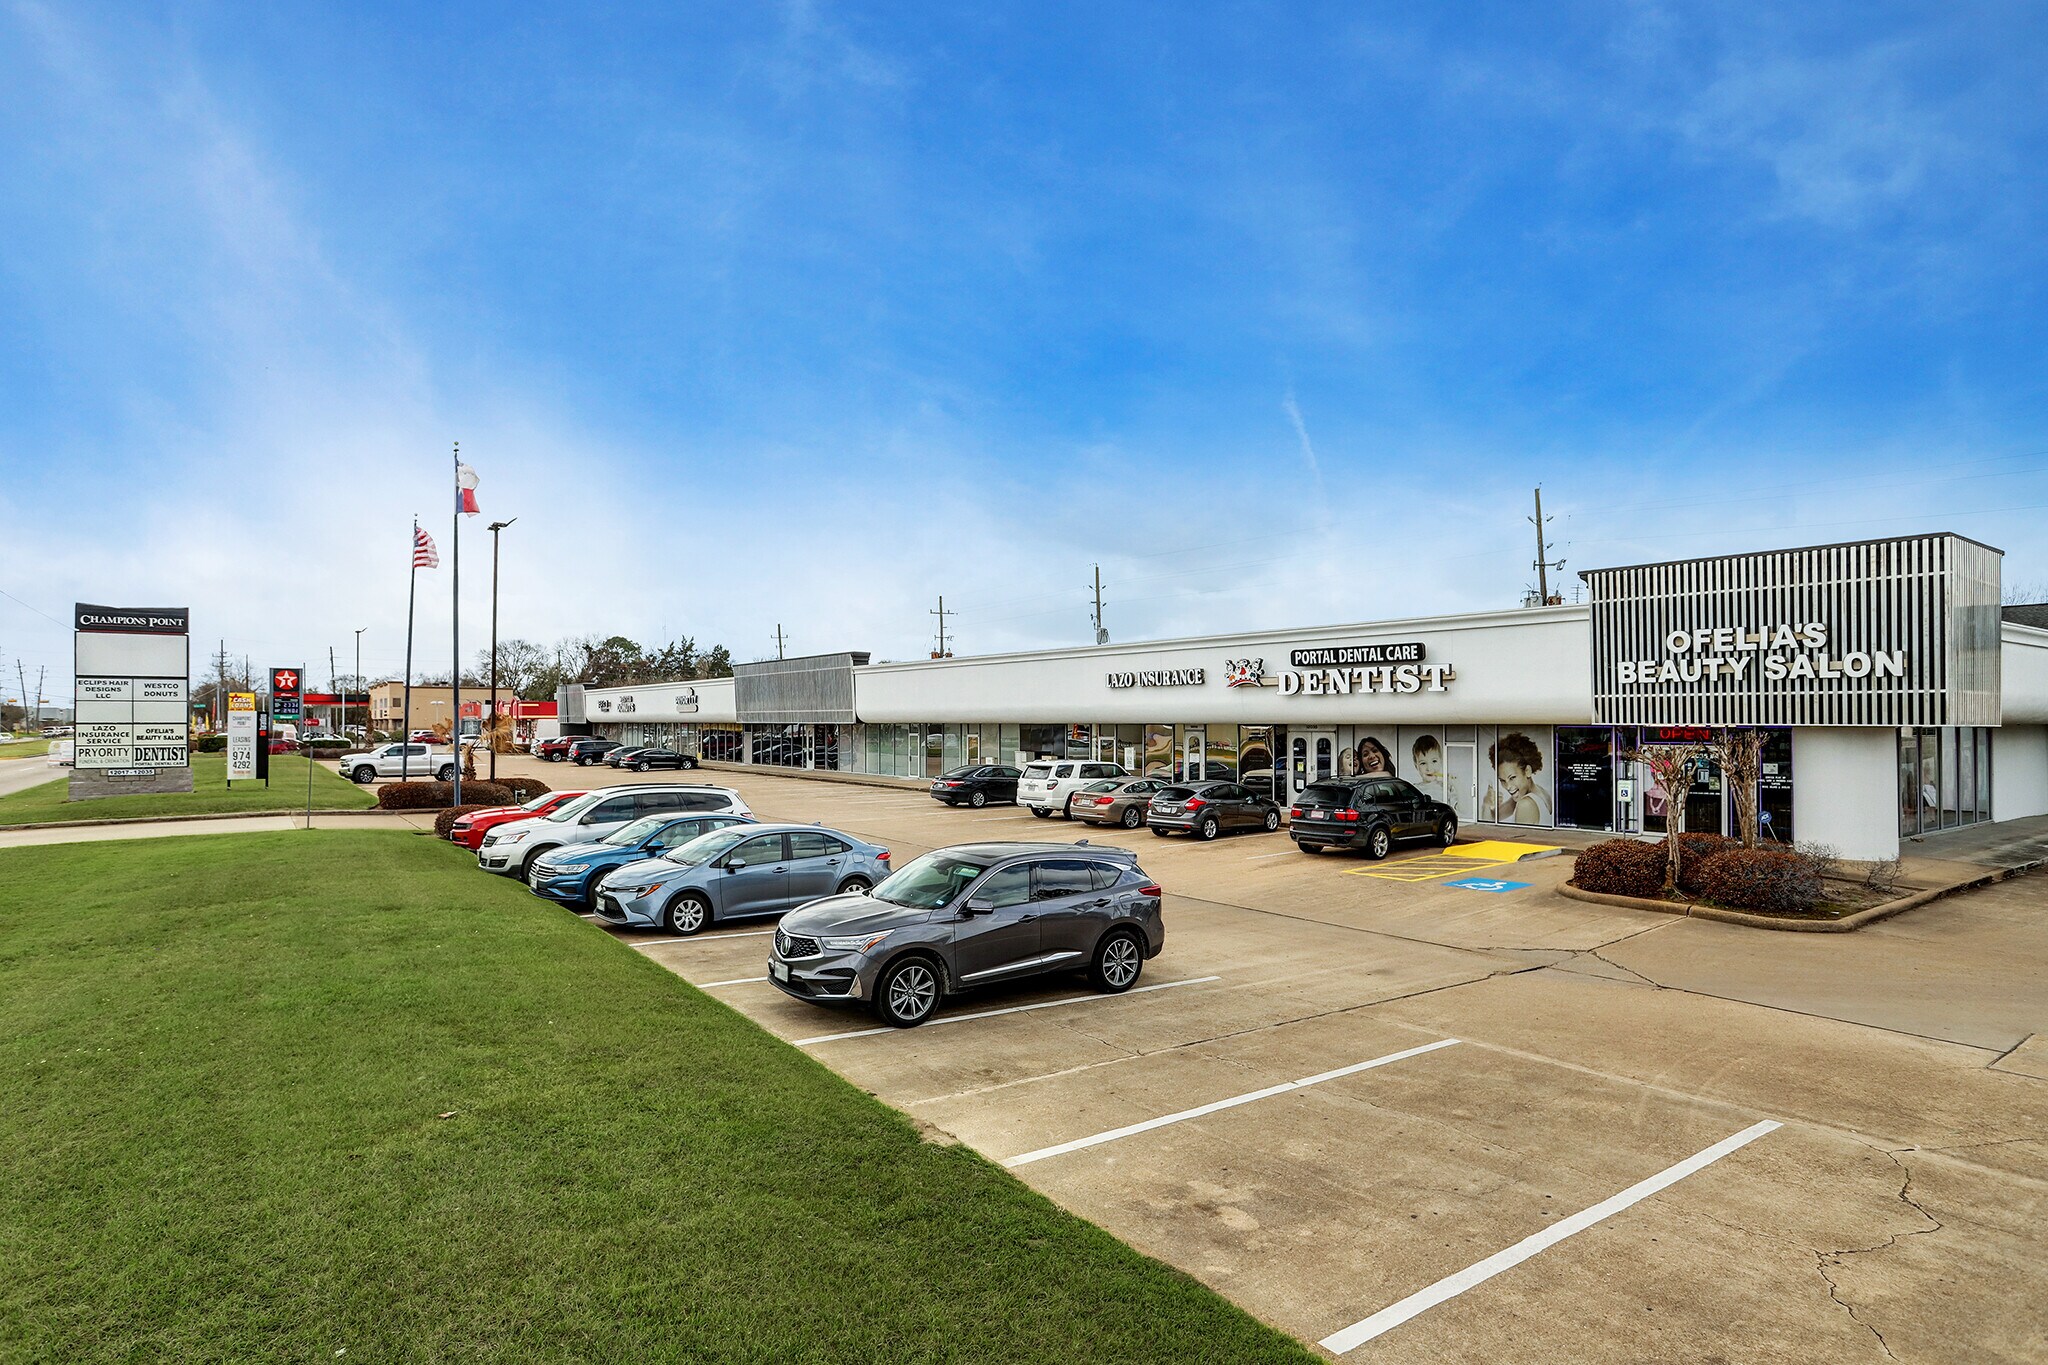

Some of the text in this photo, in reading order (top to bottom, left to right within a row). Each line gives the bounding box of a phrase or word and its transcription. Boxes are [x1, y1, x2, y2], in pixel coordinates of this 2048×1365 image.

[149, 617, 184, 628] POINT
[1667, 622, 1828, 654] OFELIA'S
[1295, 645, 1418, 665] PORTAL DENTAL CARE
[1617, 650, 1904, 684] BEAUTY SALON
[1106, 668, 1205, 688] LAZO INSURANCE
[1276, 663, 1452, 696] DENTIST
[1660, 728, 1709, 740] OPEN
[78, 748, 130, 757] PRYORITY
[134, 747, 186, 761] DENTIST
[232, 752, 251, 760] 974
[232, 760, 251, 769] 4292
